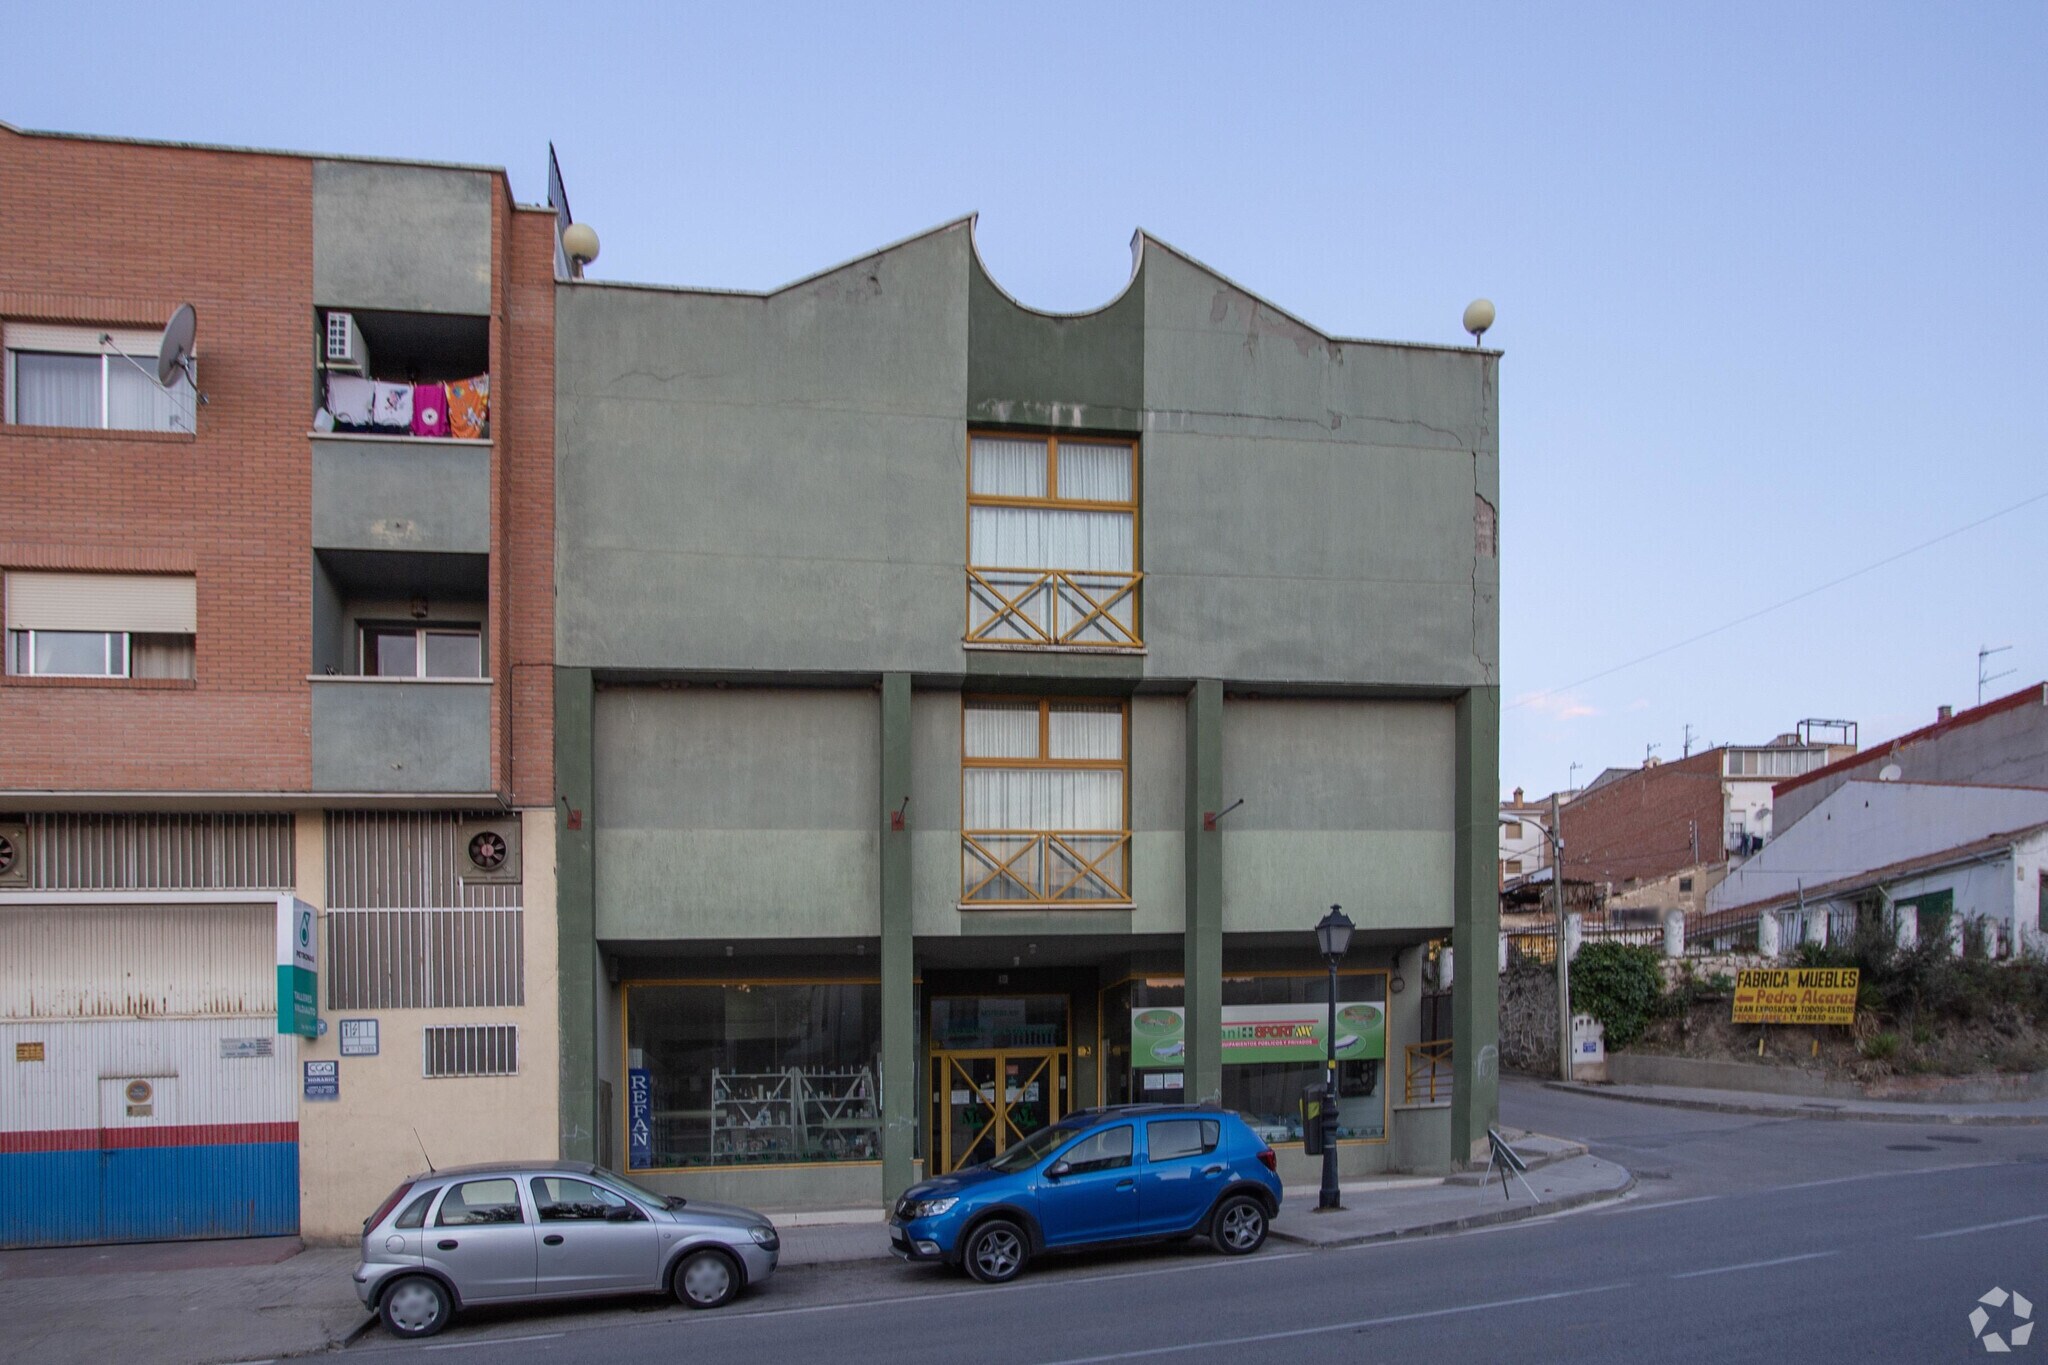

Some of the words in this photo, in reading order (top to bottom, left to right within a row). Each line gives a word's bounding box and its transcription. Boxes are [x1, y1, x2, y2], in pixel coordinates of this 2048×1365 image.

[1736, 971, 1789, 988] FABRICA
[1797, 970, 1857, 988] MUEBLES
[1756, 989, 1797, 1004] Pedro
[1801, 989, 1855, 1004] Alcaraz
[1254, 1025, 1295, 1038] SPORT
[631, 1075, 648, 1147] REFAN
